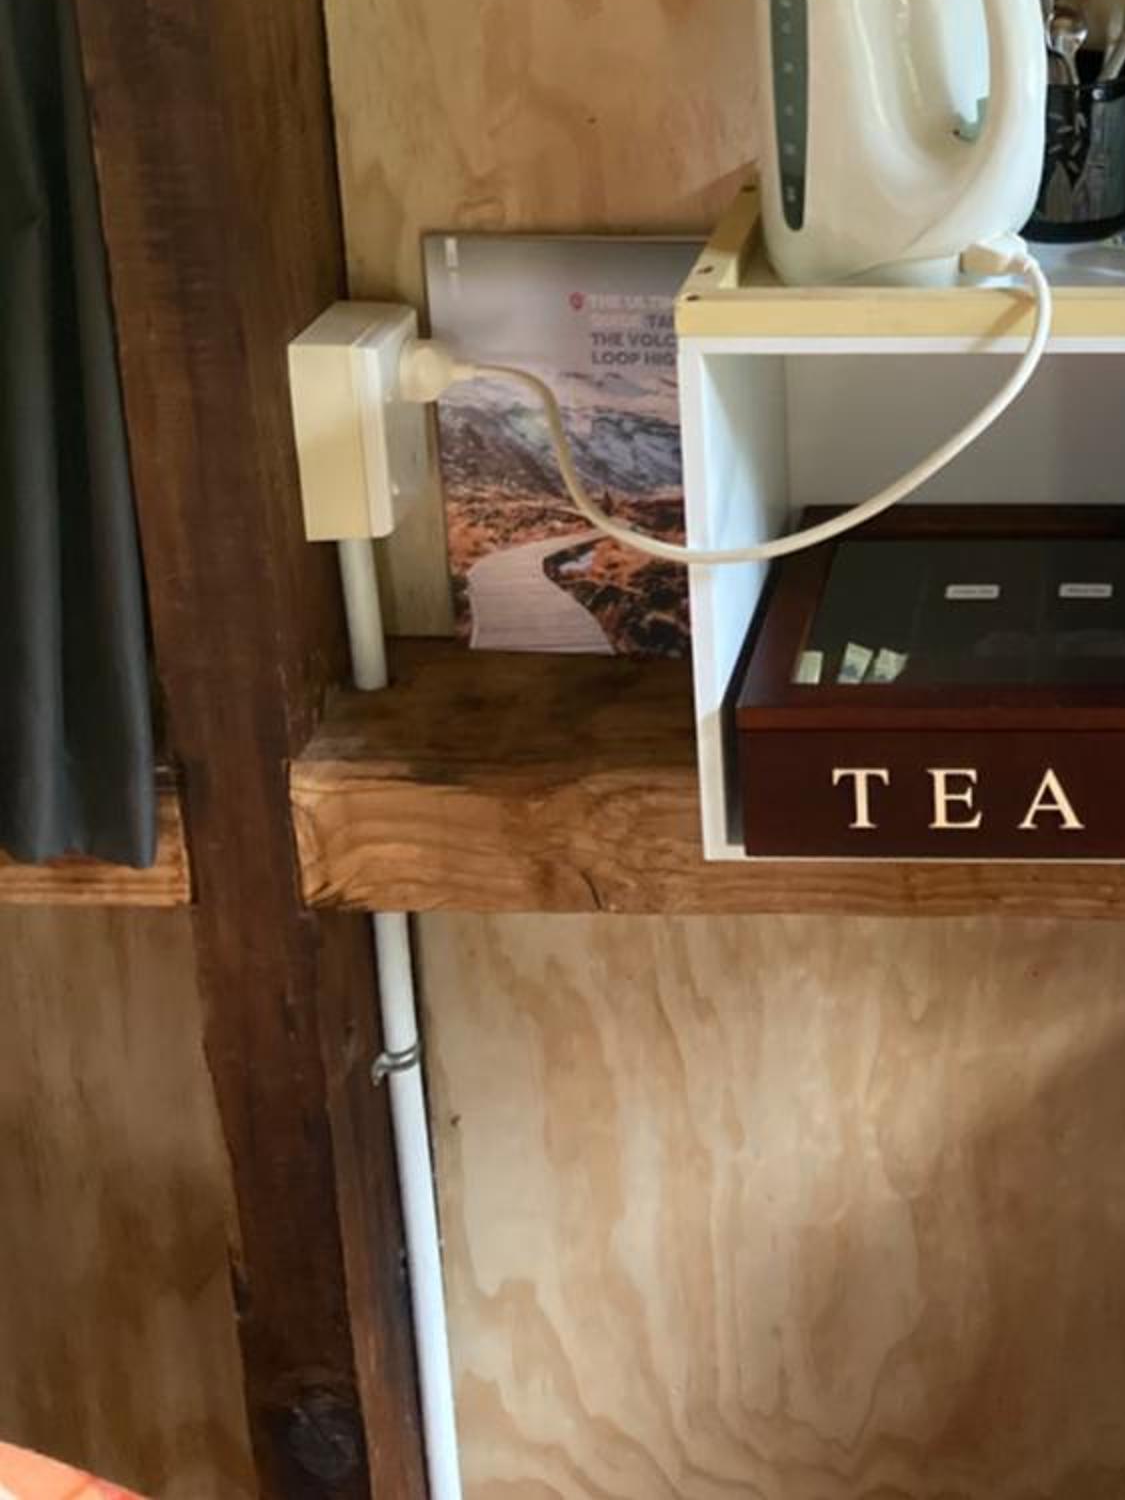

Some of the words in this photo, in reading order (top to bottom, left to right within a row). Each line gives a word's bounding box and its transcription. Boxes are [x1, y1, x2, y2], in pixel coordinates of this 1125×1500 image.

[626, 332, 677, 348] VOLC
[591, 351, 640, 365] LOOP
[643, 351, 676, 366] HIG
[832, 768, 1086, 828] TEA
